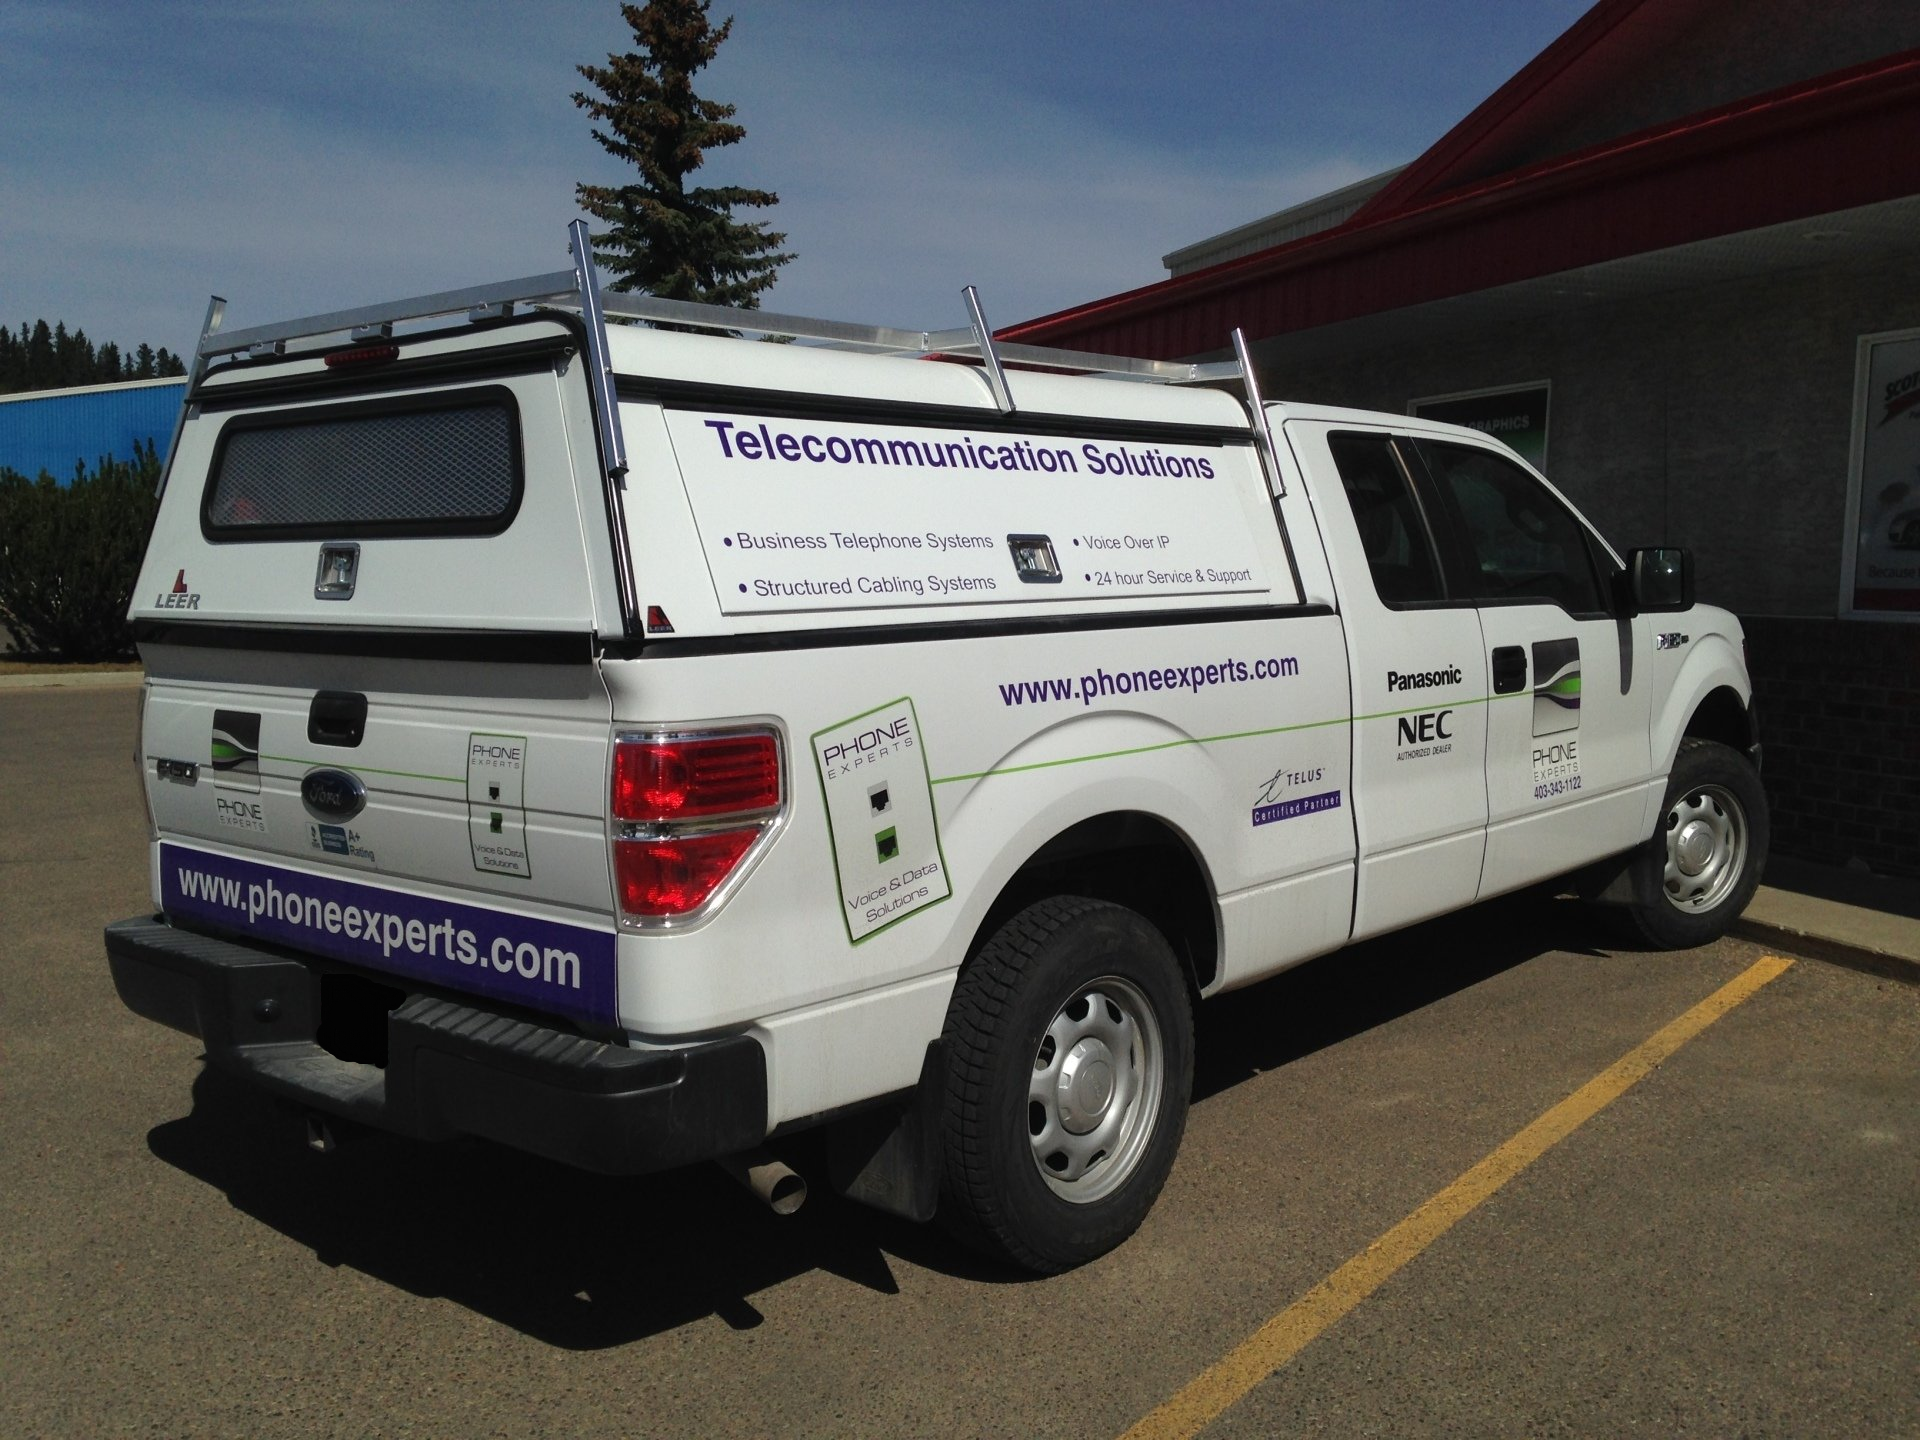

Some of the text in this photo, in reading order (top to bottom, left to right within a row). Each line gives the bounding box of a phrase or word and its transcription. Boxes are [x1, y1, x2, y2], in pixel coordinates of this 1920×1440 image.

[703, 420, 1215, 480] Telecommunication Solutions
[737, 532, 994, 552] Business Telephone Systems
[1083, 535, 1169, 550] Voice Over IP
[754, 575, 997, 597] Structured Cabling Systems
[1094, 568, 1252, 586] 24 hour Service & Support
[154, 593, 201, 610] LEER
[999, 656, 1300, 706] www.phoneexperts.com
[1387, 664, 1462, 692] Panasonic
[1397, 710, 1453, 746] NEC
[473, 745, 520, 760] PHONE
[823, 717, 910, 766] PHONE
[1397, 744, 1452, 761] AUTHORIZED DEALER
[472, 759, 520, 769] EXPERTS
[828, 737, 914, 780] EXPERTS
[1532, 741, 1577, 768] PHONE
[1287, 768, 1322, 786] TELUS
[1534, 761, 1579, 782] EXPERTS
[1534, 775, 1582, 800] 403-343-1122
[217, 798, 263, 820] PHONE
[1254, 795, 1339, 823] Certified Partner
[220, 815, 265, 831] EXPERTS
[349, 845, 376, 862] Rating
[474, 843, 496, 855] Voice
[504, 847, 525, 859] Data
[483, 857, 519, 870] Solutions
[848, 862, 939, 911] Voice & Data
[866, 885, 929, 923] Solutions
[178, 866, 582, 989] www.phoneexperts.com
